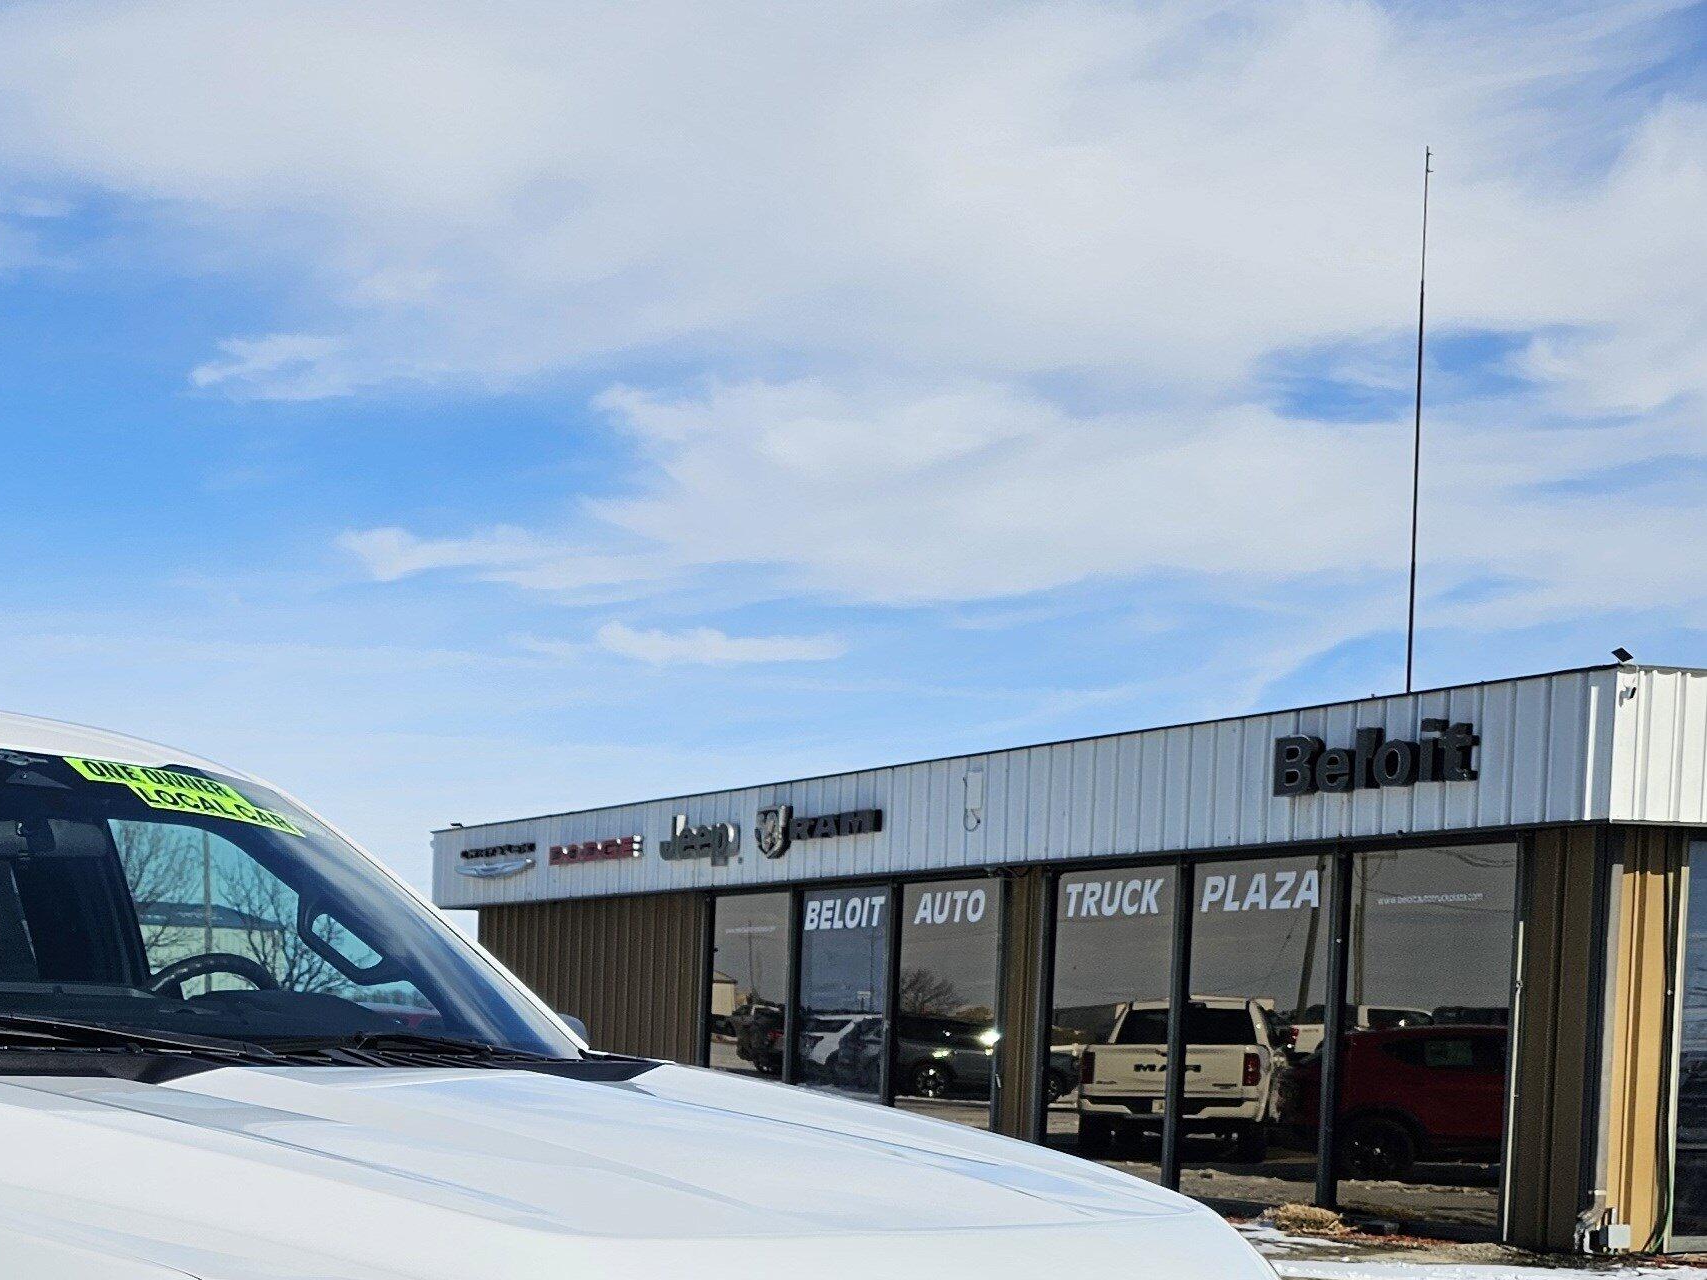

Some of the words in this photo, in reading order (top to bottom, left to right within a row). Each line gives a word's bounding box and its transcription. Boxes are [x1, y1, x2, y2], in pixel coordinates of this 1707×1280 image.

[81, 759, 141, 781] ONE
[141, 767, 231, 798] OWNER
[1273, 717, 1480, 797] Beloit
[135, 785, 236, 815] LOCAL
[235, 803, 297, 832] CAR
[793, 809, 883, 840] RAM
[659, 814, 740, 867] Jeep
[803, 895, 886, 931] BELOIT
[913, 888, 986, 925] AUTO
[1065, 878, 1164, 918] TRUCK
[1200, 869, 1319, 913] PLAZA
